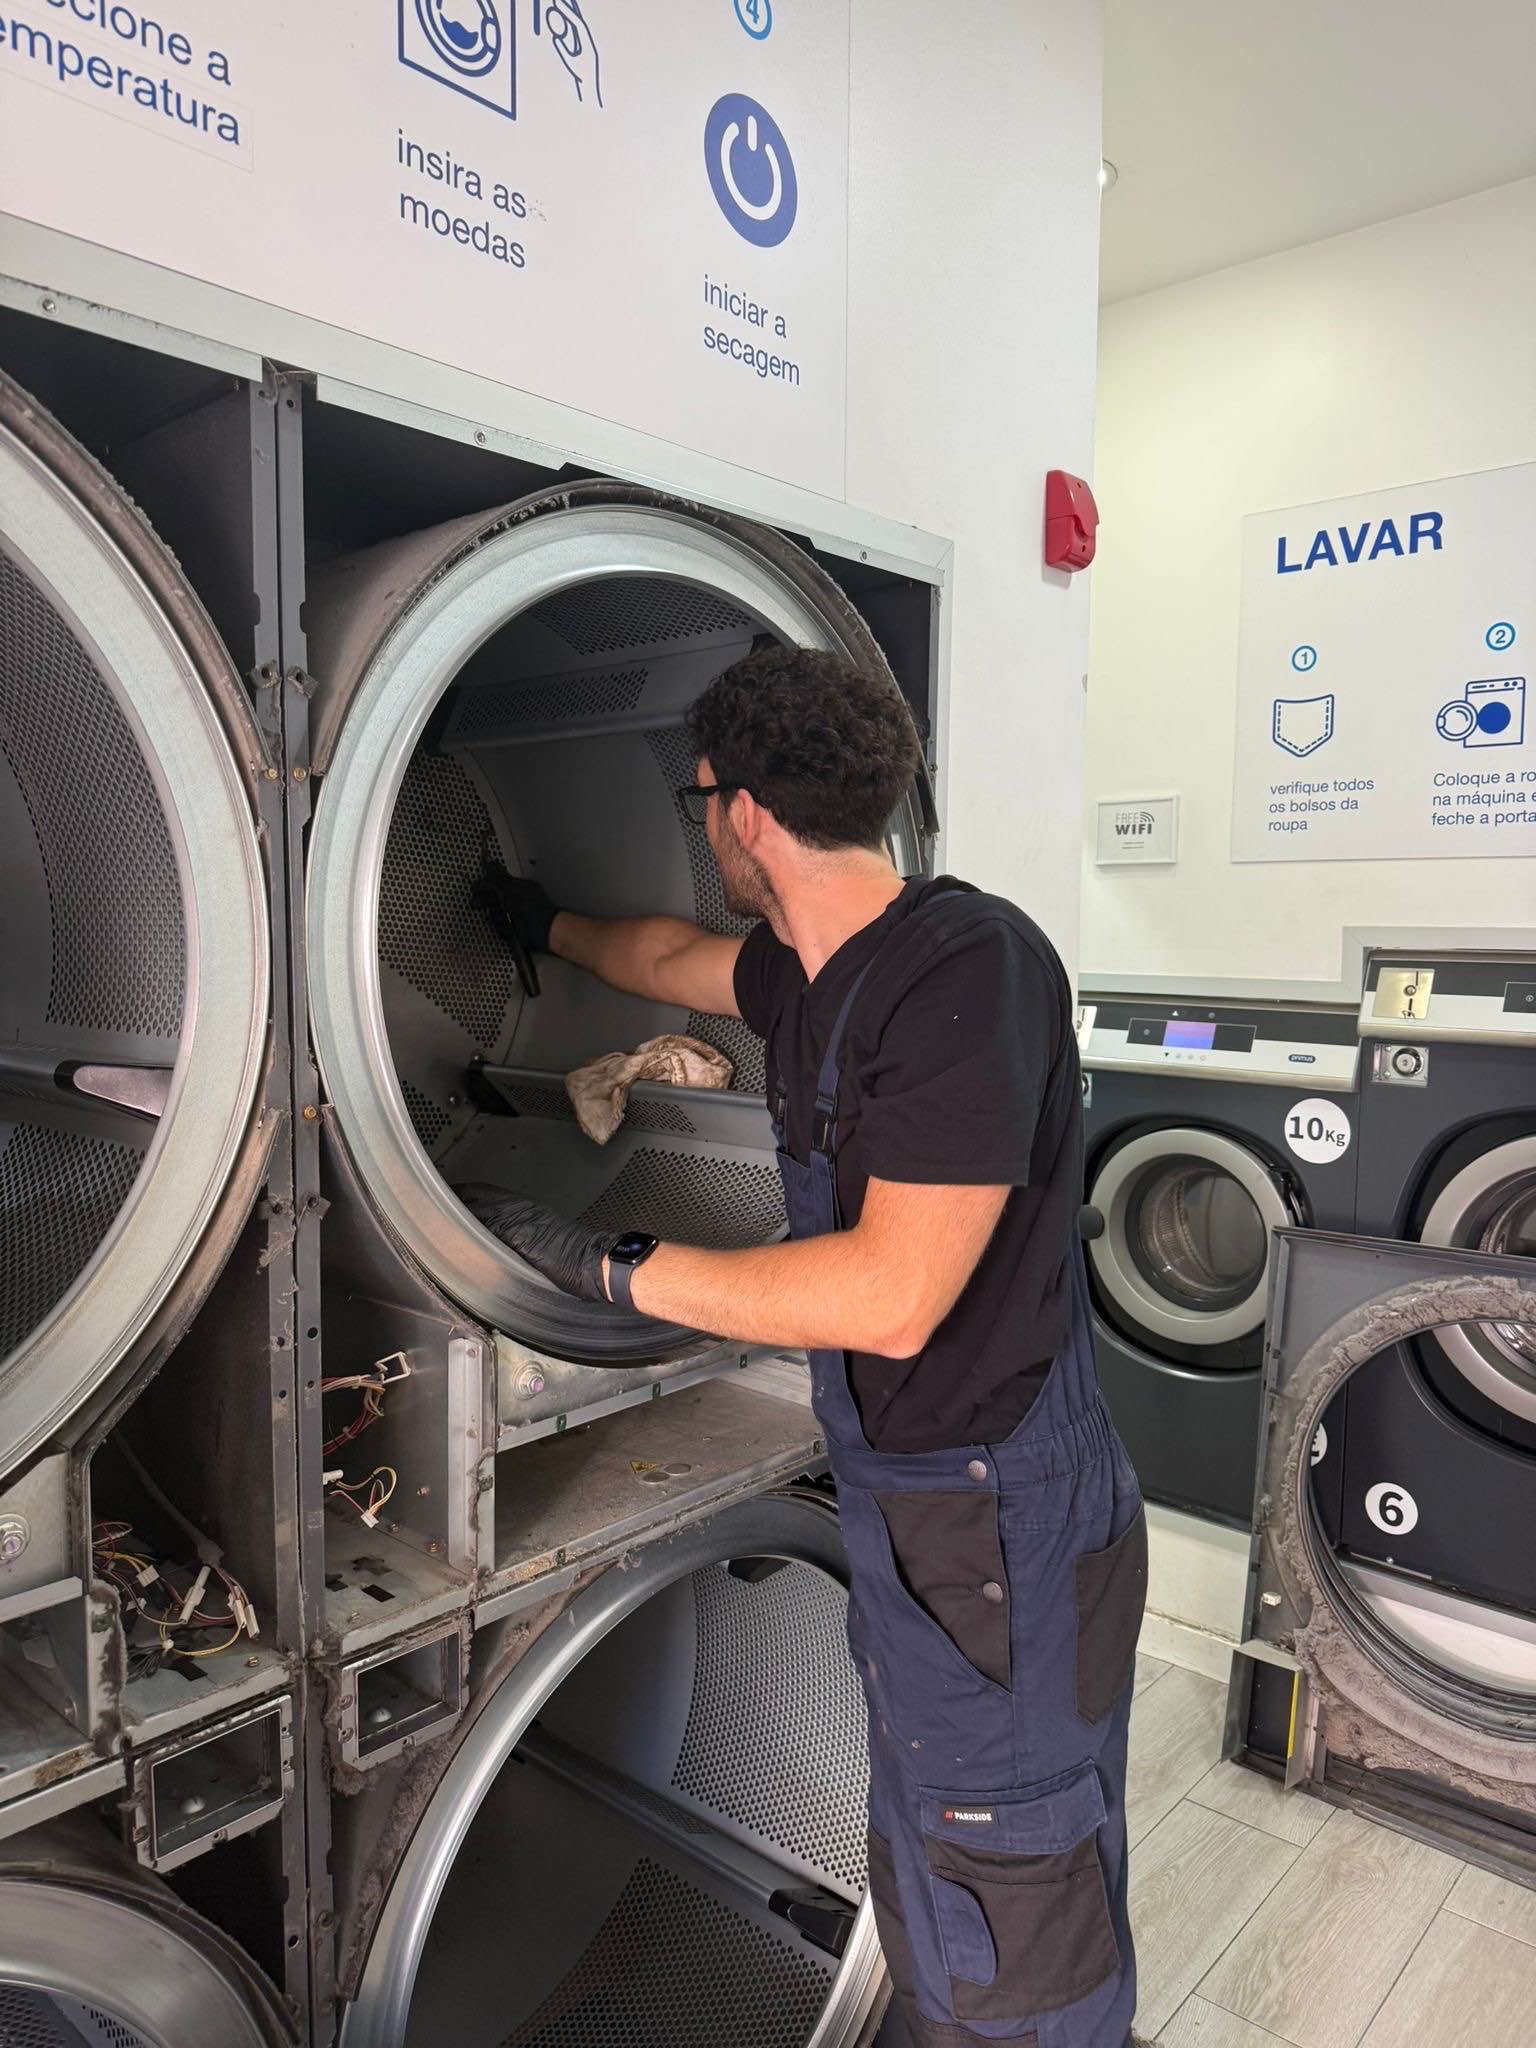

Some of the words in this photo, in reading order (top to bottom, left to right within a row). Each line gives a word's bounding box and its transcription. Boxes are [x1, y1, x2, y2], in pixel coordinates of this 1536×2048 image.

[46, 0, 192, 65] cione
[207, 51, 231, 86] a
[0, 15, 240, 145] mperatura
[399, 128, 482, 200] insira
[493, 184, 526, 218] as
[400, 193, 525, 268] moedas
[703, 273, 769, 329] iniciar
[774, 315, 788, 339] a
[703, 325, 801, 386] secagem
[1277, 511, 1443, 574] LAVAR
[1494, 628, 1507, 645] 2
[1301, 651, 1310, 666] 1
[1269, 780, 1330, 796] verifique
[1332, 777, 1375, 793] todos
[1432, 771, 1501, 789] Coloque
[1505, 771, 1516, 784] a
[1268, 802, 1286, 814] os
[1289, 799, 1337, 813] bolsos
[1340, 796, 1360, 810] da
[1432, 794, 1452, 807] na
[1456, 789, 1527, 808] máquina
[1267, 819, 1308, 834] roupa
[1431, 811, 1475, 826] feche
[1479, 812, 1490, 825] a
[1494, 809, 1536, 828] porta
[1115, 824, 1152, 835] WIFI
[1379, 1491, 1404, 1527] 6
[954, 1811, 992, 1821] PARKSIDE
